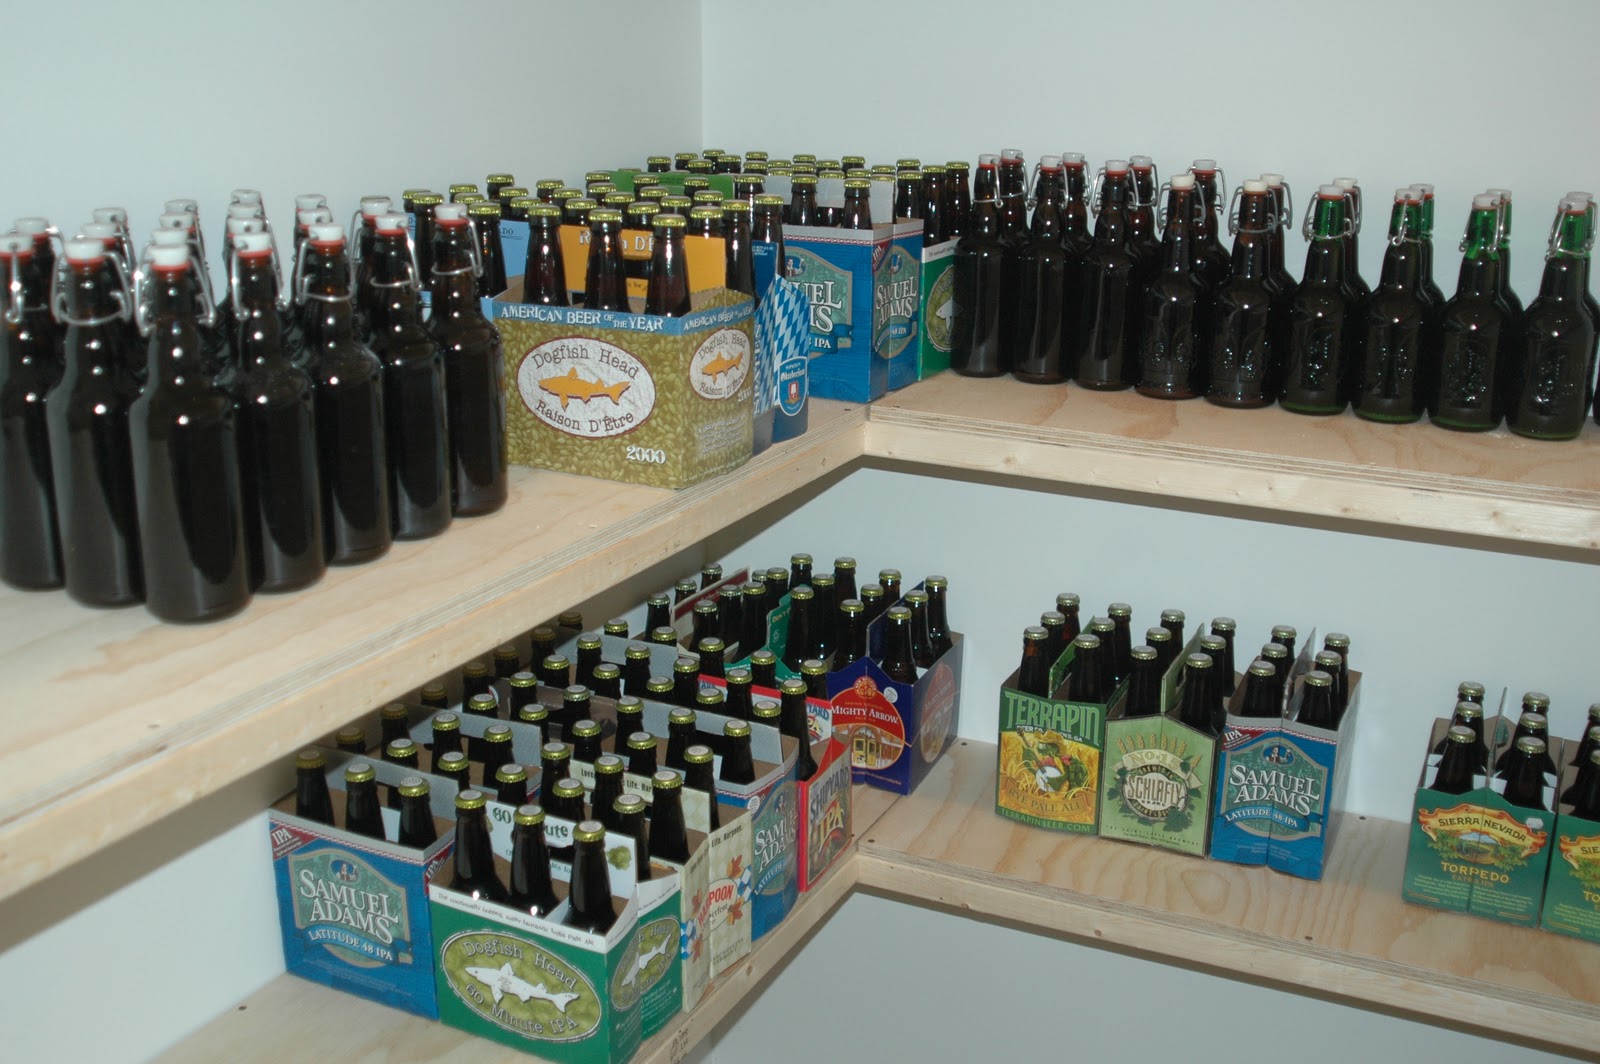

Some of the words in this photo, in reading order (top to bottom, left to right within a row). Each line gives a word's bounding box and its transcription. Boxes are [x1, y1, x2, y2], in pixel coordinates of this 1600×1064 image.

[876, 276, 917, 309] SAMUEL
[501, 305, 563, 323] AMERICAN
[567, 311, 601, 325] BEER
[604, 313, 614, 322] OF
[613, 320, 628, 328] THE
[629, 317, 664, 332] YEAR
[683, 313, 718, 331] AMERICAN
[718, 310, 734, 323] BEER
[878, 298, 913, 330] ADAMS
[698, 333, 727, 360] Dogfish
[814, 337, 831, 349] IPA
[532, 345, 590, 369] Dogfish
[599, 347, 640, 380] Head
[700, 382, 723, 396] Raison
[535, 400, 581, 431] Raison
[589, 411, 634, 433] D'Être
[626, 445, 666, 464] 2000
[831, 705, 867, 715] MIGHTY
[869, 709, 898, 724] ARROW
[1005, 691, 1100, 747] TERRAPIN
[1225, 729, 1244, 742] IPA
[581, 768, 595, 779] Love
[626, 779, 640, 790] Life.
[1229, 765, 1320, 800] SAMUEL
[810, 767, 849, 823] SHIPYARD
[1009, 789, 1027, 804] RYE
[1031, 801, 1059, 813] PALE
[1061, 801, 1082, 813] ALE
[1127, 775, 1184, 806] SCHLAFLY
[1234, 784, 1311, 816] ADAMS
[493, 807, 512, 824] 60
[819, 802, 845, 853] IPA
[1001, 808, 1091, 832] TERRAPINBEER.COM
[1225, 808, 1271, 822] LATITUDE
[1274, 812, 1283, 821] 48
[1285, 815, 1298, 827] IPA
[271, 828, 293, 845] IPA
[711, 836, 722, 849] Life.
[754, 808, 798, 856] SAMUEL
[1438, 817, 1480, 827] SIERRA
[1482, 819, 1527, 843] NEVADA
[759, 828, 796, 874] ADAMS
[425, 859, 439, 881] IPA
[1441, 861, 1509, 884] TORPEDO
[299, 869, 400, 924] SAMUEL
[438, 892, 448, 901] The
[310, 898, 393, 945] ADAMS
[308, 930, 360, 949] LATITUDE
[362, 943, 374, 954] 48
[376, 948, 394, 961] IPA
[463, 939, 524, 960] Dogfish
[534, 952, 578, 991] Head
[464, 983, 484, 1005] 60
[491, 1004, 544, 1034] Minute
[550, 1015, 579, 1035] IPA
